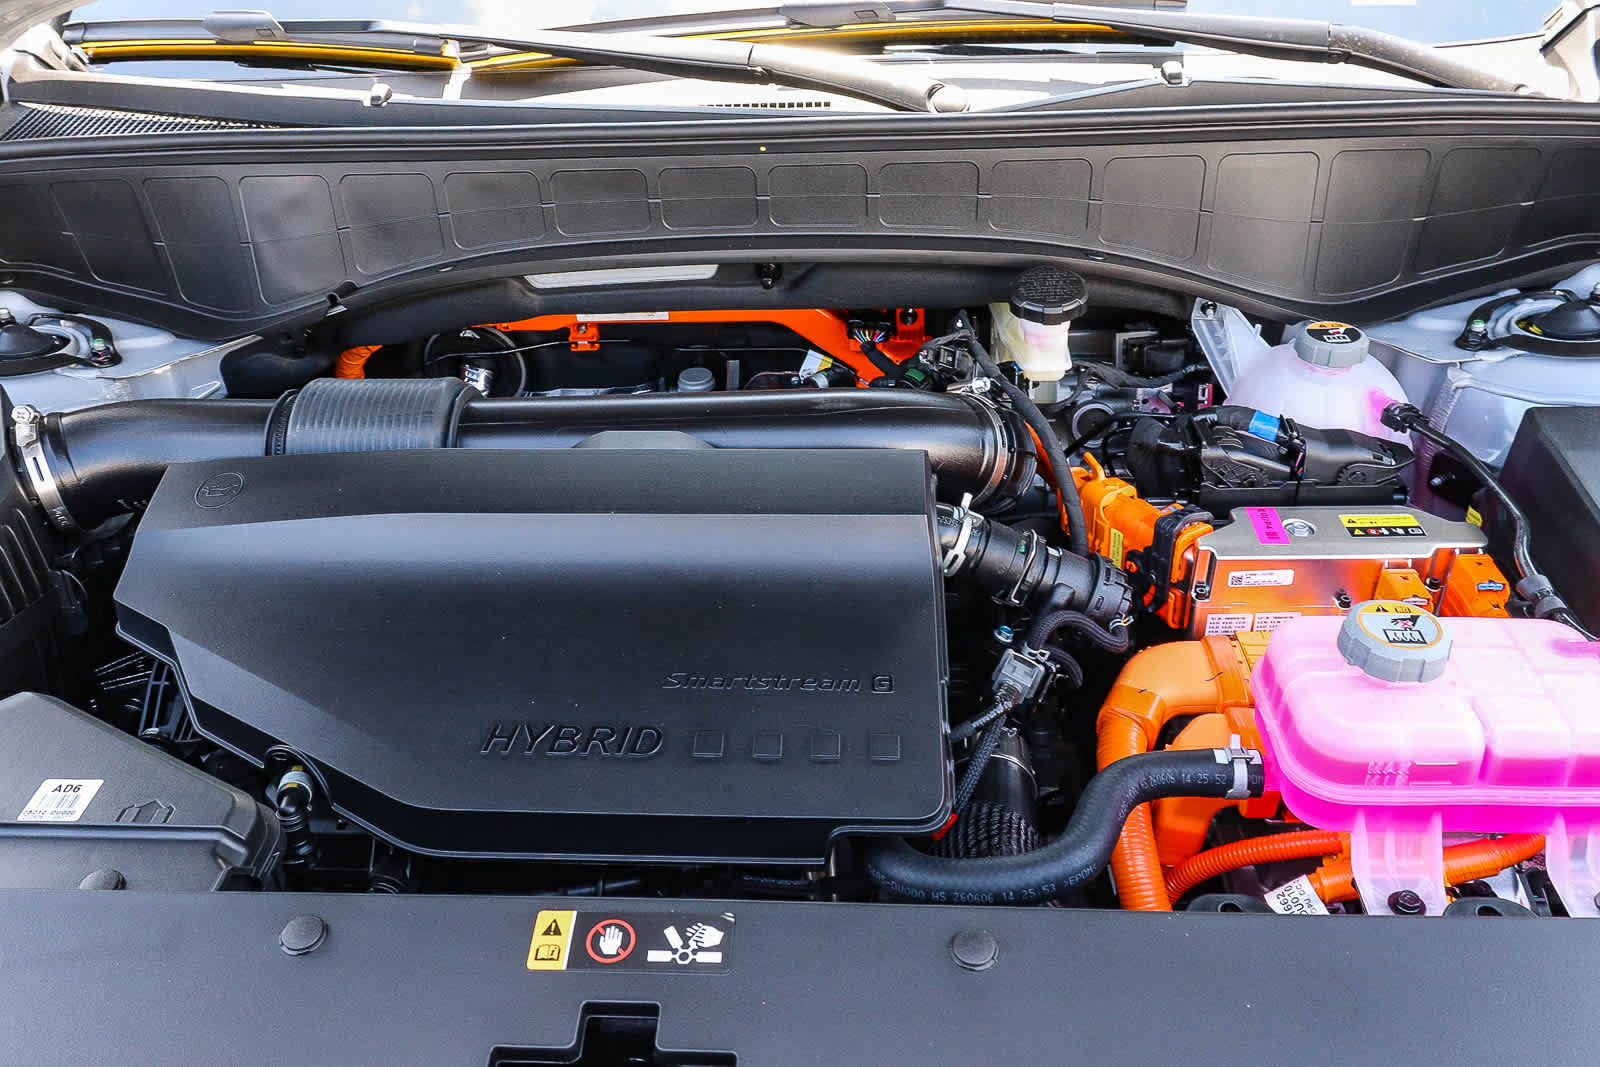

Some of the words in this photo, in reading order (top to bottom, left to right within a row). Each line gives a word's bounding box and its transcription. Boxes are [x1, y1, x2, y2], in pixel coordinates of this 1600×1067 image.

[662, 672, 862, 693] Smartstream
[872, 674, 895, 694] G
[478, 722, 664, 758] HYBRID
[51, 784, 83, 793] AD6
